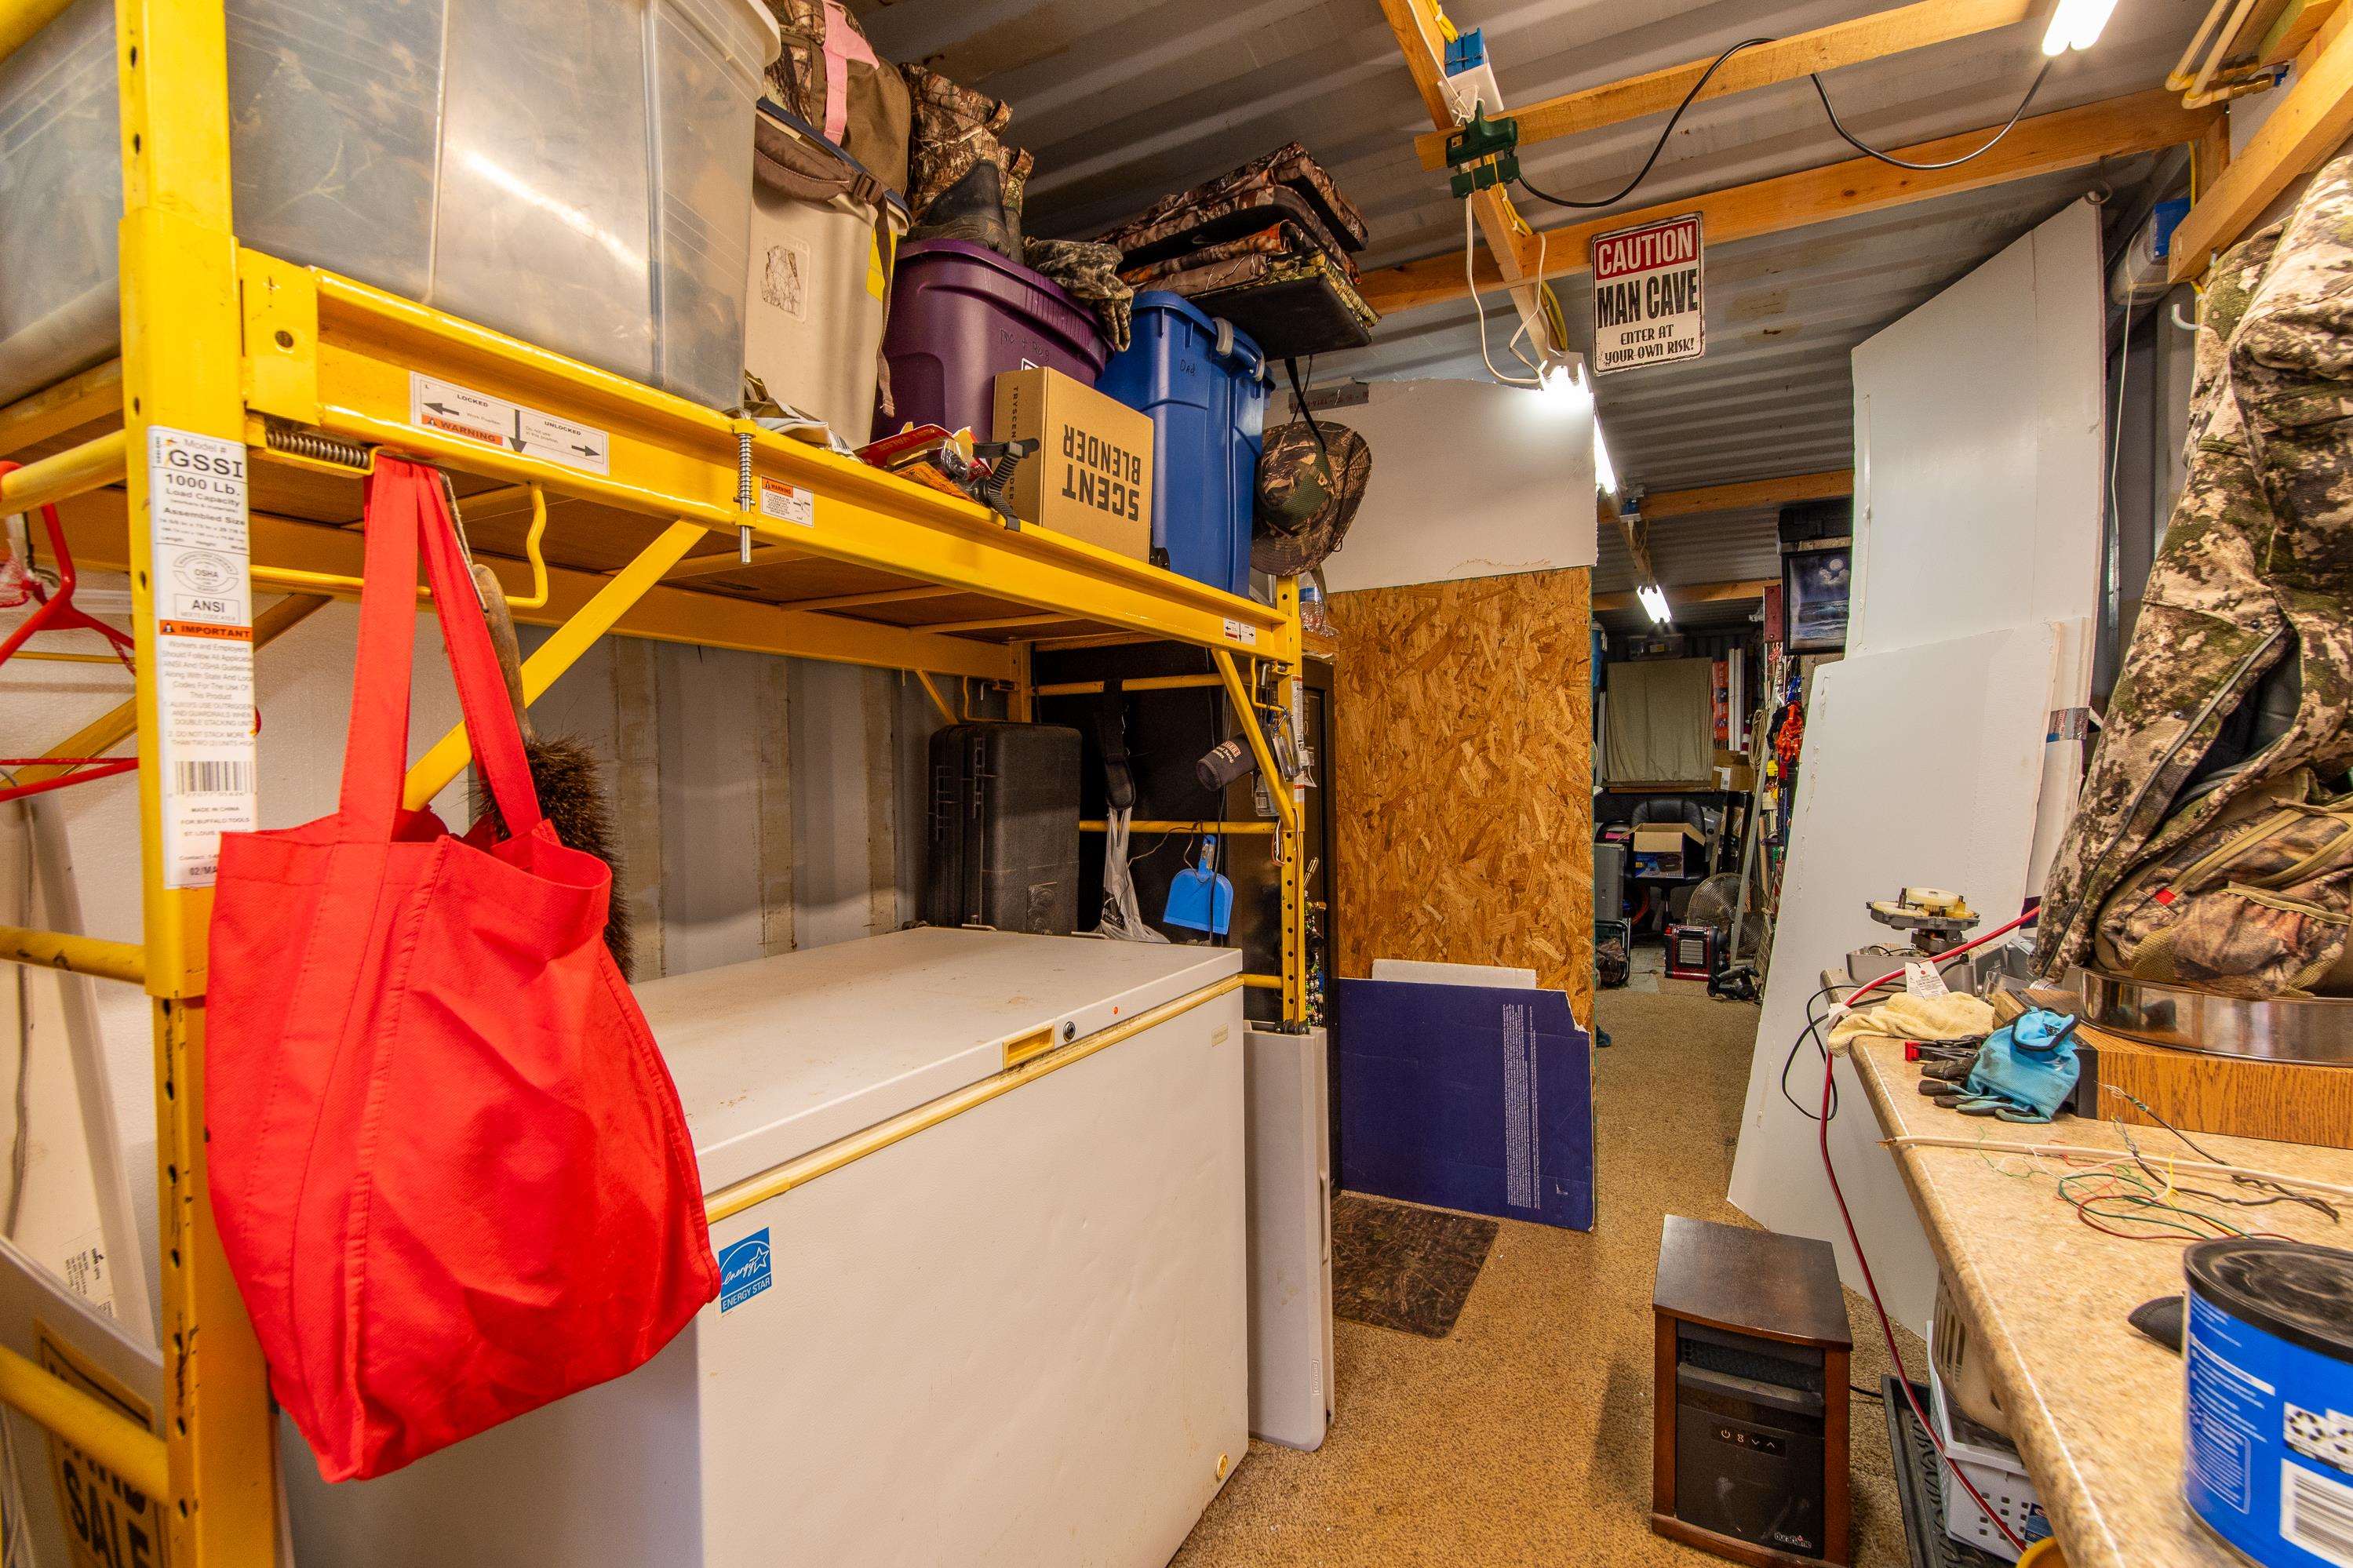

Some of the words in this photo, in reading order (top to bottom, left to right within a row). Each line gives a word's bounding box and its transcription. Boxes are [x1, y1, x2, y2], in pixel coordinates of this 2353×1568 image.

[1598, 224, 1693, 275] CAUTION
[1597, 279, 1641, 329] MAN
[1646, 267, 1698, 319] CAVE
[1620, 327, 1655, 345] ENTER
[1658, 324, 1674, 337] AT
[1604, 347, 1635, 365] YOUR
[1637, 343, 1663, 360] OWN
[1667, 337, 1695, 354] RISK!
[457, 394, 489, 408] LOCKED
[440, 422, 496, 442] WARNING
[545, 420, 581, 436] UNLOCKED
[185, 439, 217, 453] Model
[1063, 424, 1141, 486] BLENDER
[169, 449, 243, 478] GSSI
[165, 474, 207, 489] 1000
[214, 482, 240, 496] Lb.
[771, 484, 791, 495] WARNING
[1062, 464, 1140, 522] SCENT
[166, 488, 192, 497] Load
[195, 493, 239, 507] Capacity
[163, 508, 222, 522] Assembled
[225, 517, 246, 526] Size
[194, 569, 219, 578] OSHA
[191, 599, 225, 613] ANSI
[180, 625, 250, 637] IMPORTANT
[722, 1286, 752, 1310] ENERGY
[752, 1278, 770, 1293] STAR
